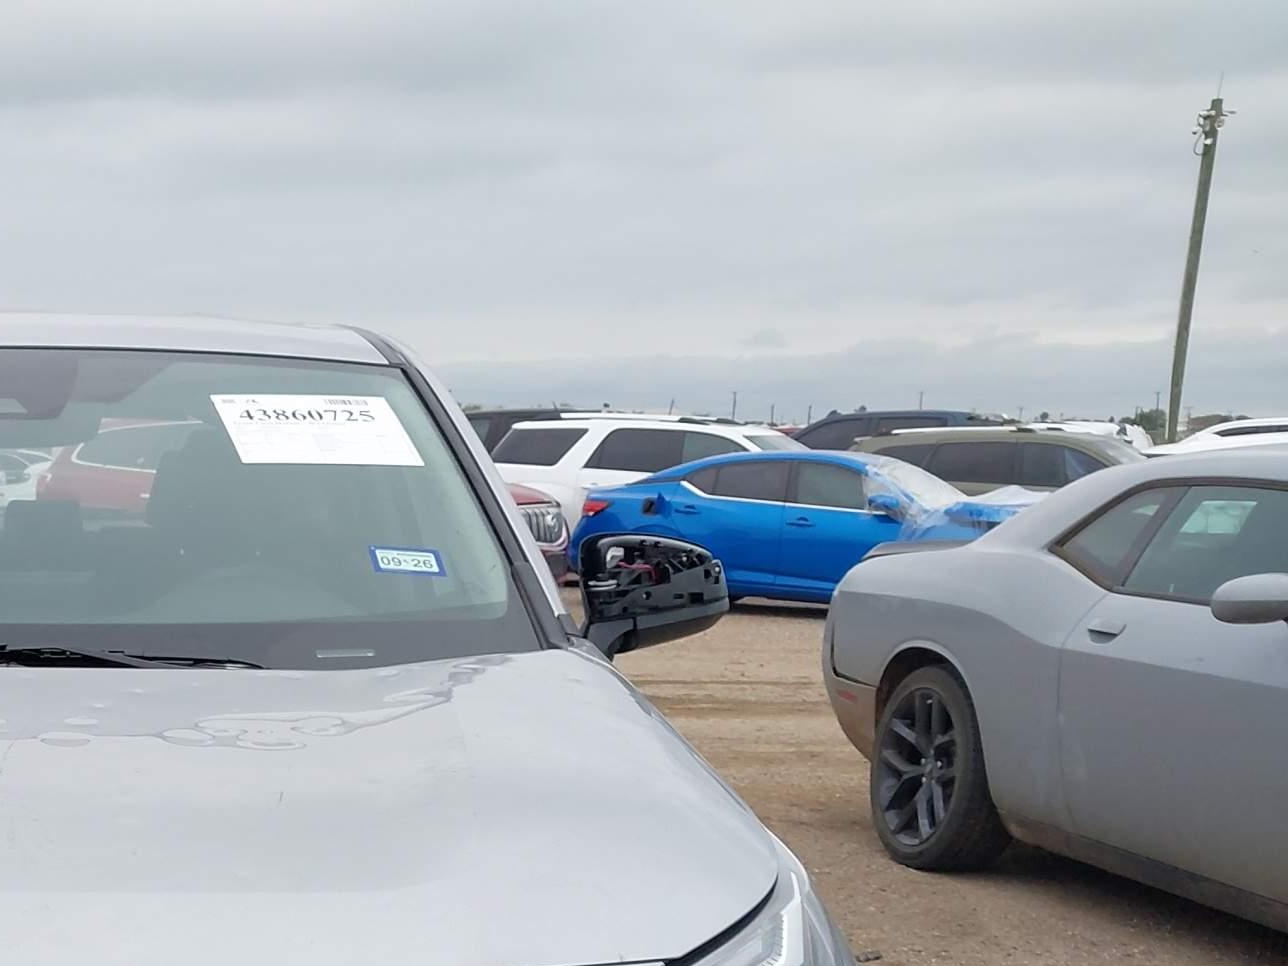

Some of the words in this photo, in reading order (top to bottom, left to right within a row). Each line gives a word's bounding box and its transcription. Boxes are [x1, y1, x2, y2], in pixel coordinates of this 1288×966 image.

[239, 408, 376, 422] 43860725
[380, 556, 402, 567] 09
[410, 558, 434, 569] 26
